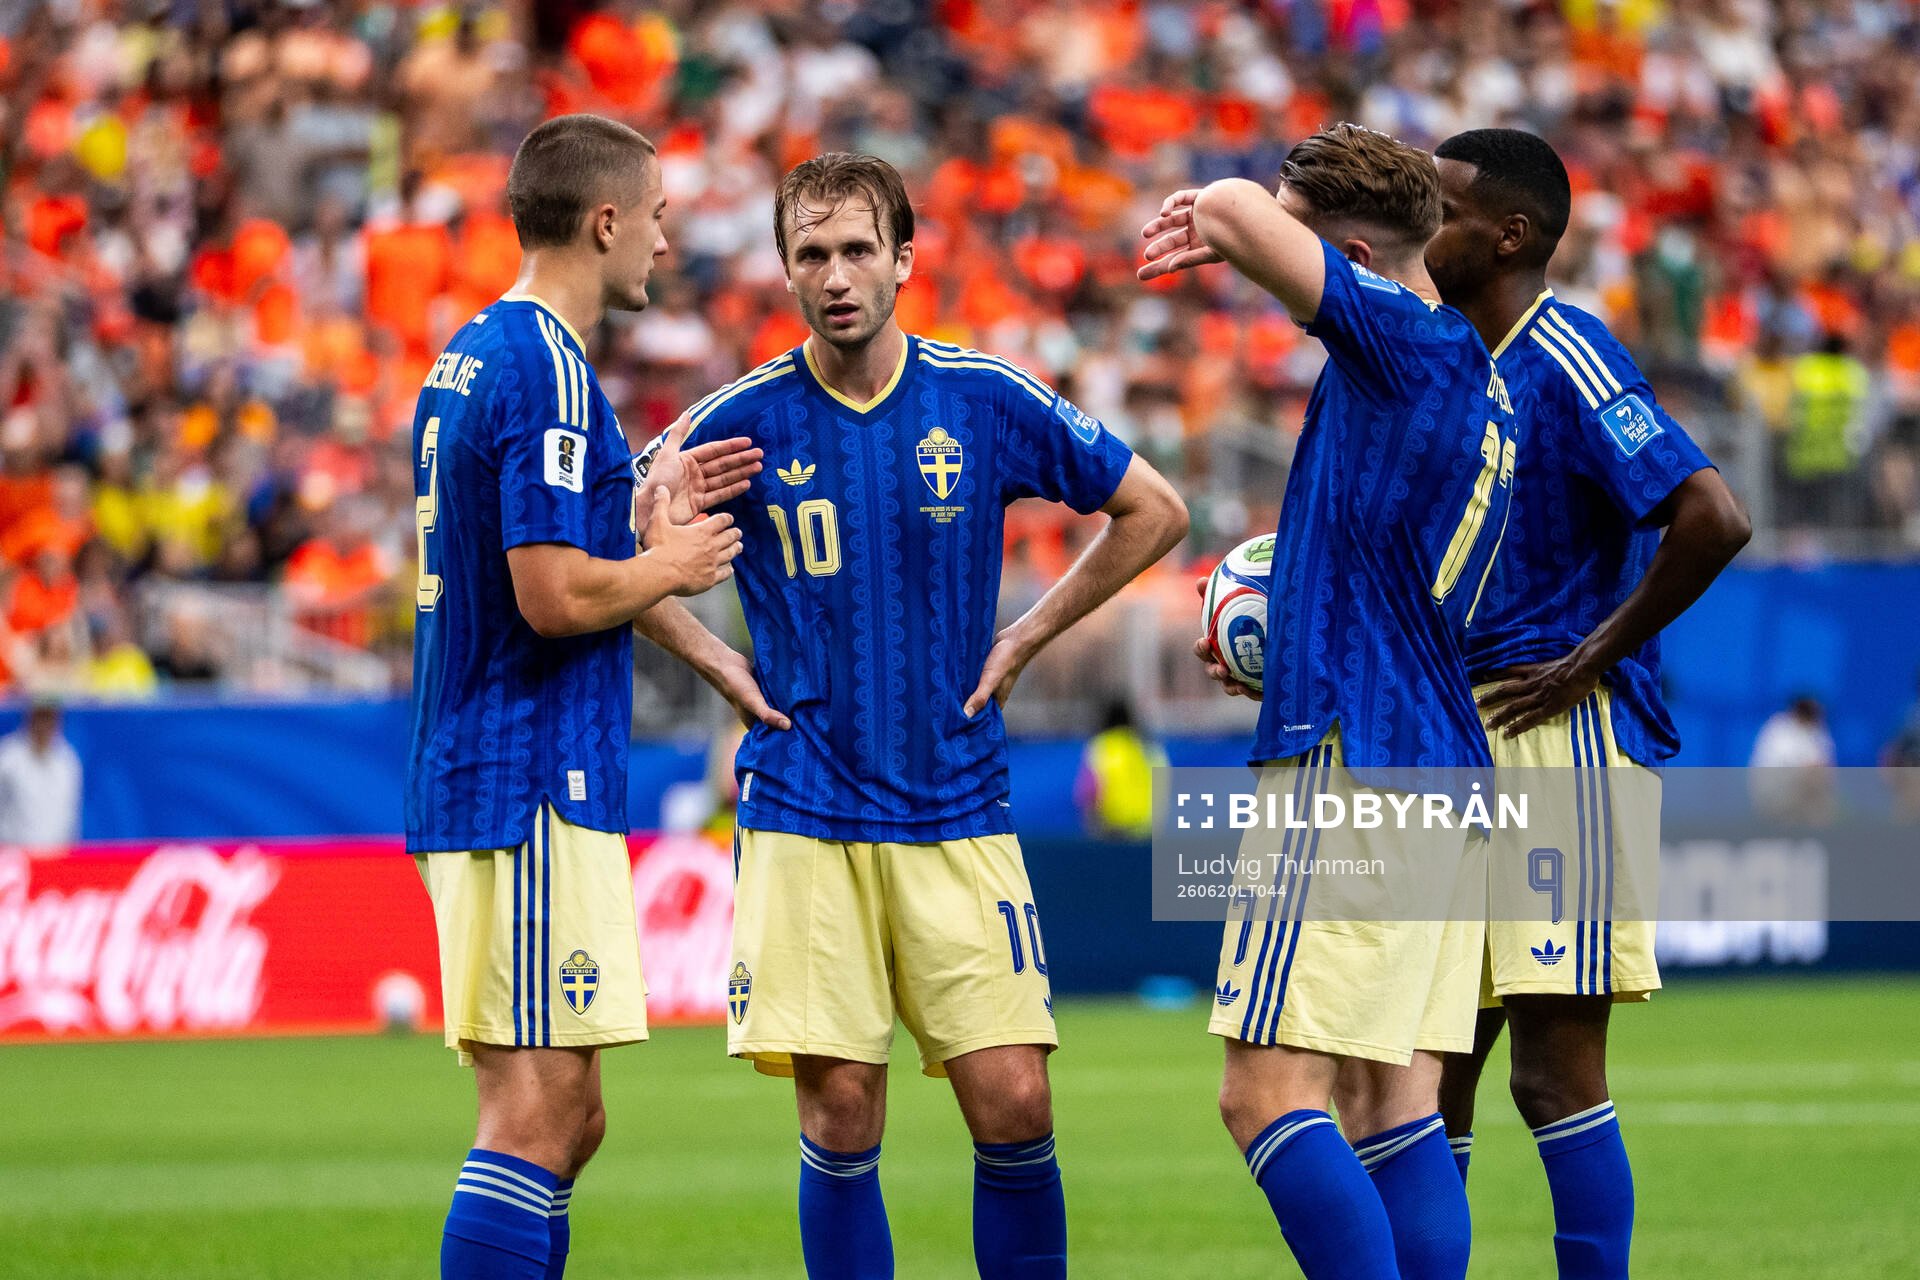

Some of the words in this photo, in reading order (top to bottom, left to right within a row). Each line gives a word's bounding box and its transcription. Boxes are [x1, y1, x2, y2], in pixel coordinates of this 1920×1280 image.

[923, 446, 956, 454] SVERIGE
[1627, 420, 1649, 442] PEACE
[416, 416, 444, 612] 2
[766, 498, 842, 580] 10
[1527, 847, 1566, 926] 9
[997, 900, 1049, 976] 10
